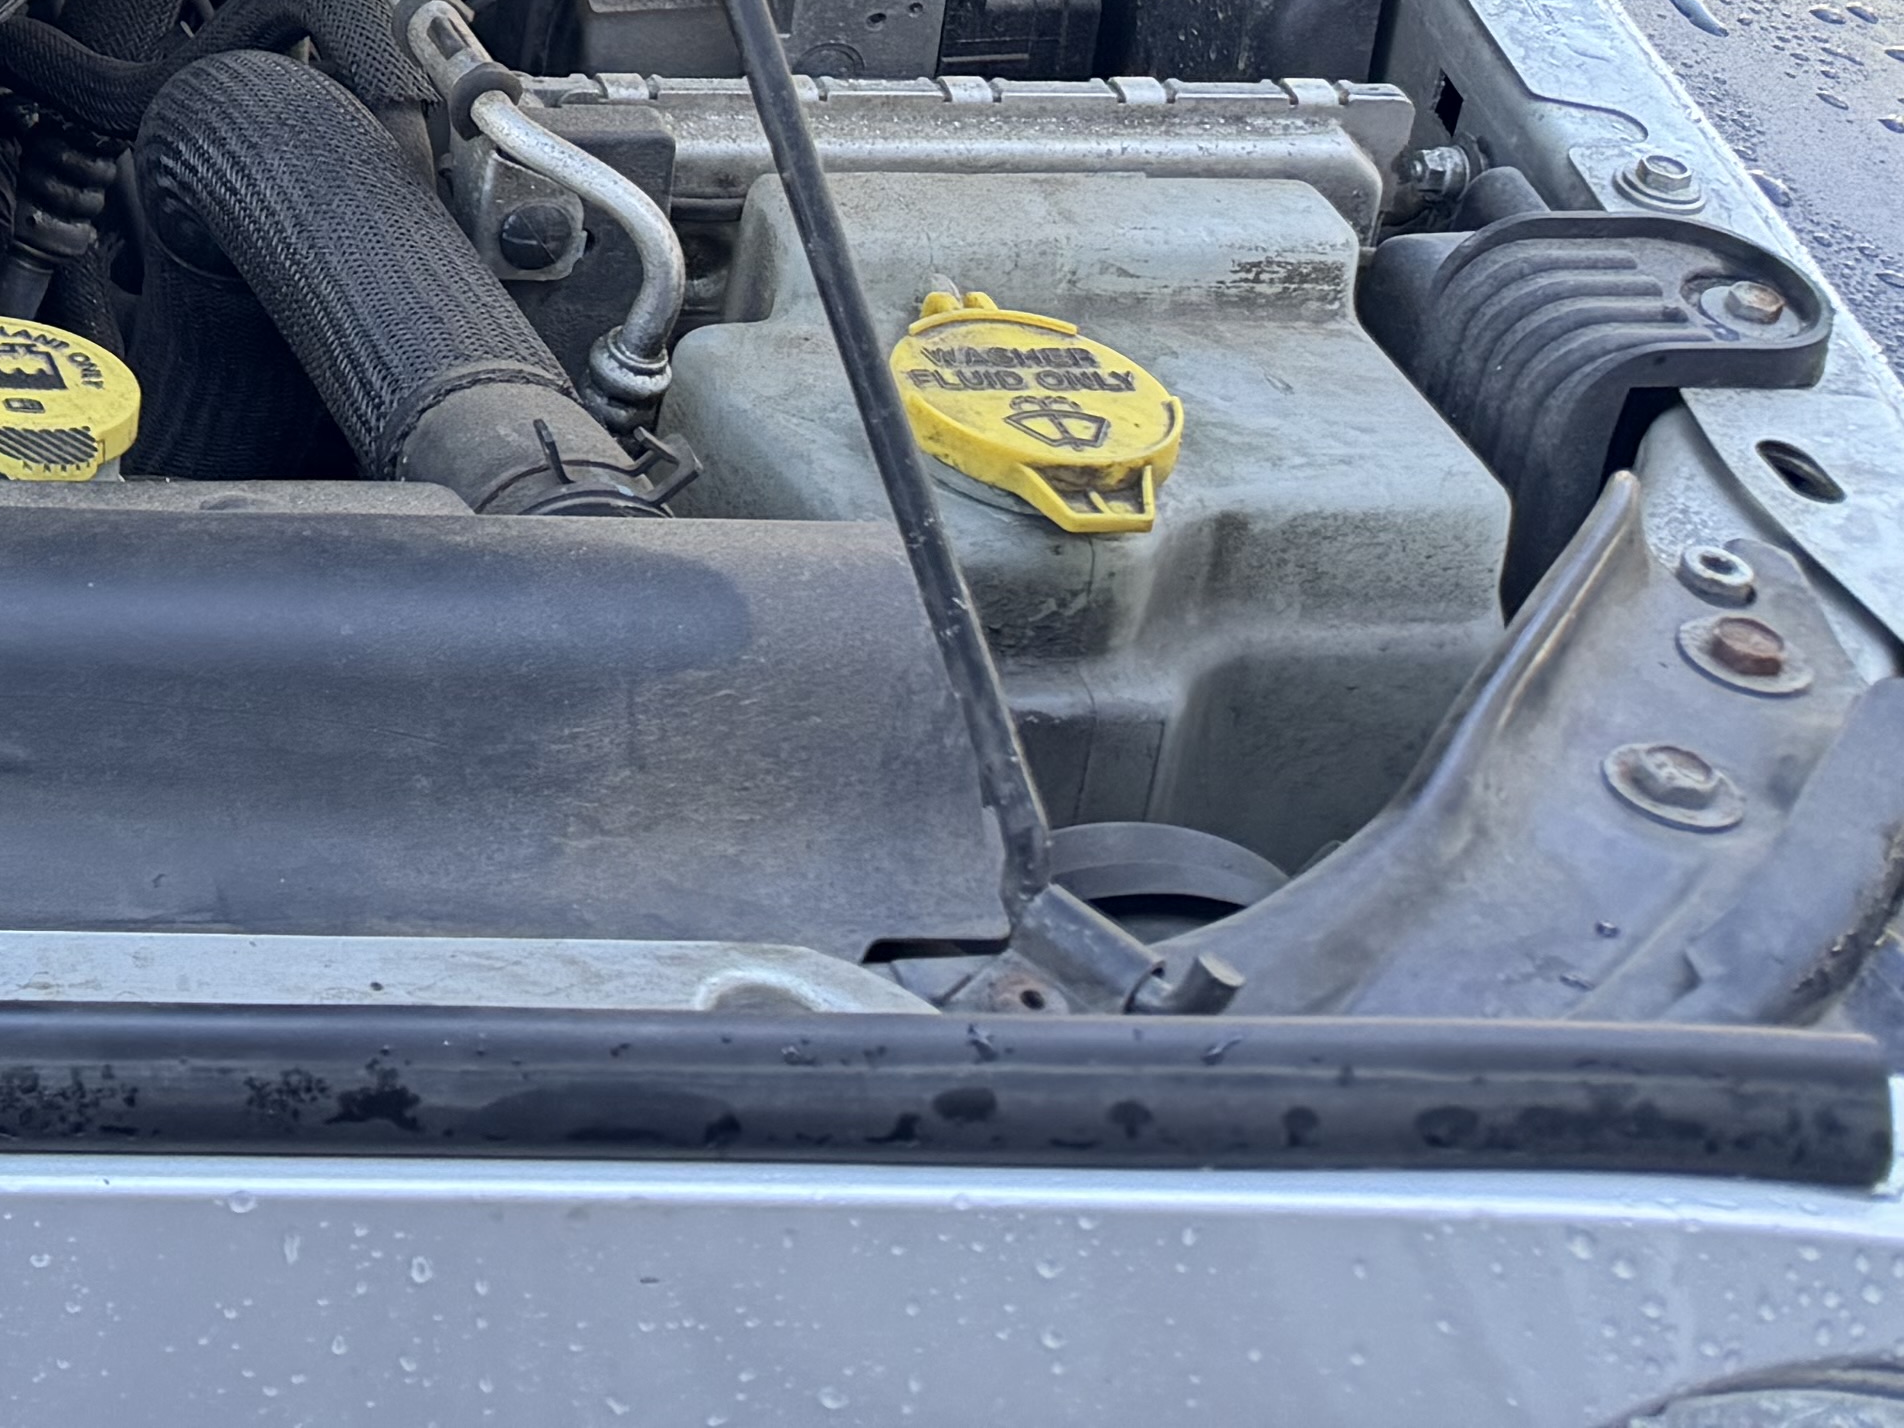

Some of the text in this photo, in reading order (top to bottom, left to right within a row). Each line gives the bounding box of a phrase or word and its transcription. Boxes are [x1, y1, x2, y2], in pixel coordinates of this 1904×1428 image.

[67, 350, 105, 390] ONLY
[919, 346, 1100, 369] WASHER
[904, 368, 1138, 394] FLUID ONLY
